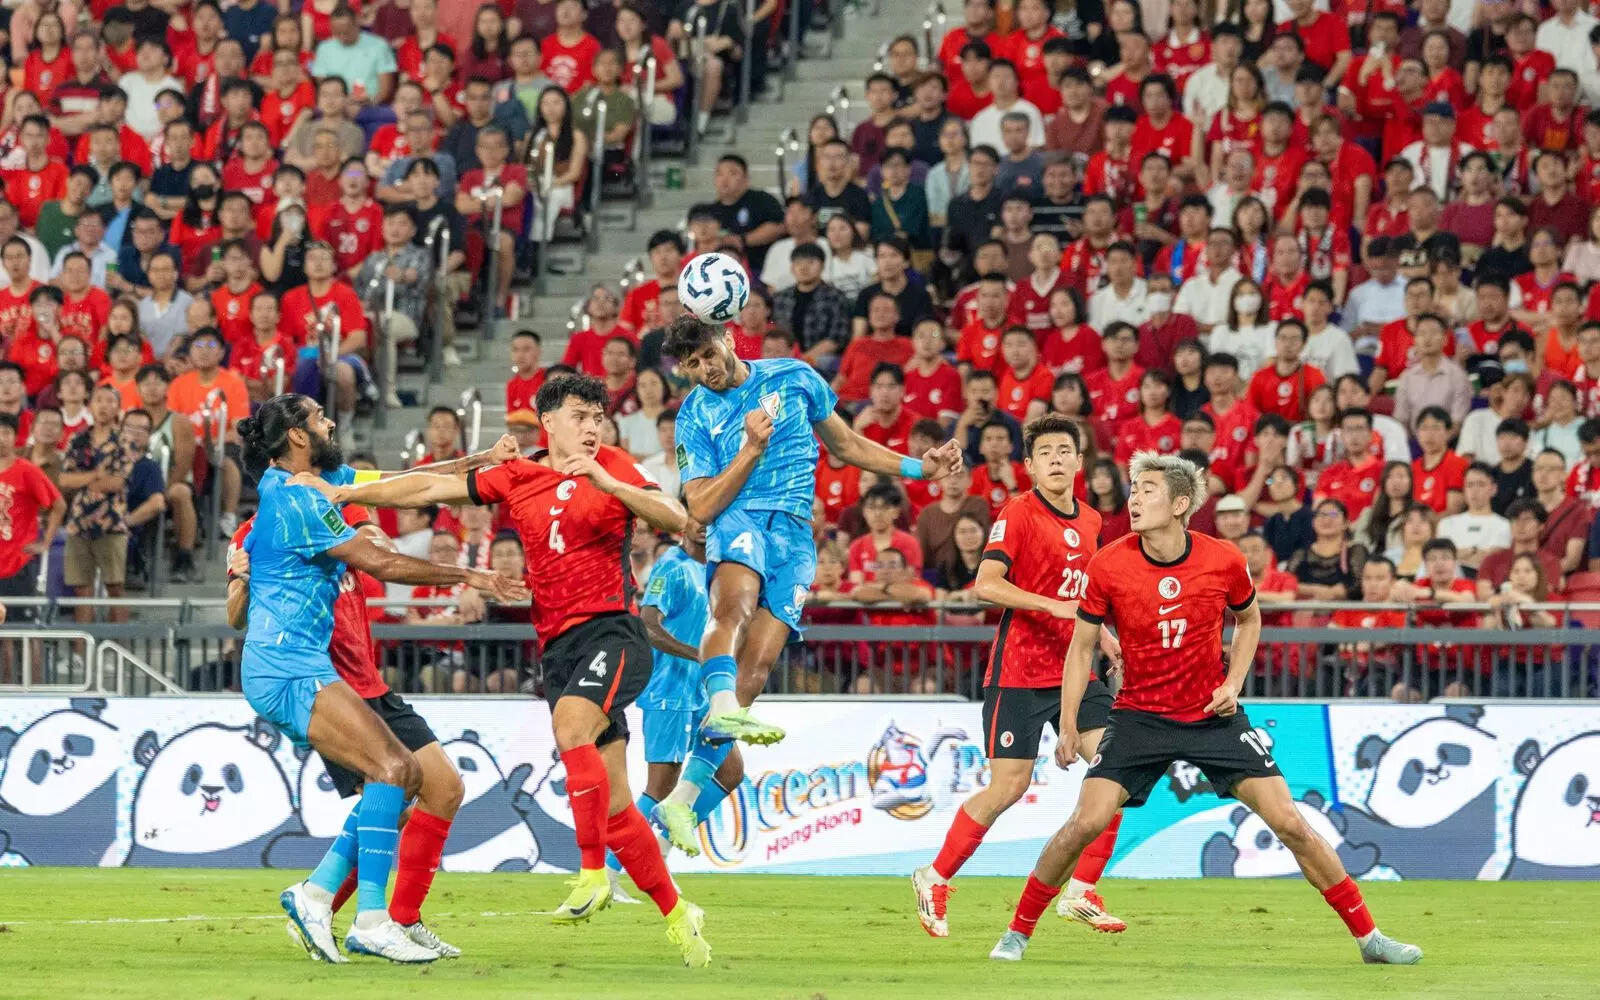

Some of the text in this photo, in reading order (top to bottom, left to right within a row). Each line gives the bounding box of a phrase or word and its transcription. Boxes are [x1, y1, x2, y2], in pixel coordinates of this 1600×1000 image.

[549, 520, 566, 554] 4
[730, 532, 753, 555] 4
[1157, 618, 1187, 649] 17
[589, 650, 607, 678] 4
[766, 808, 862, 861] Hong Kong
